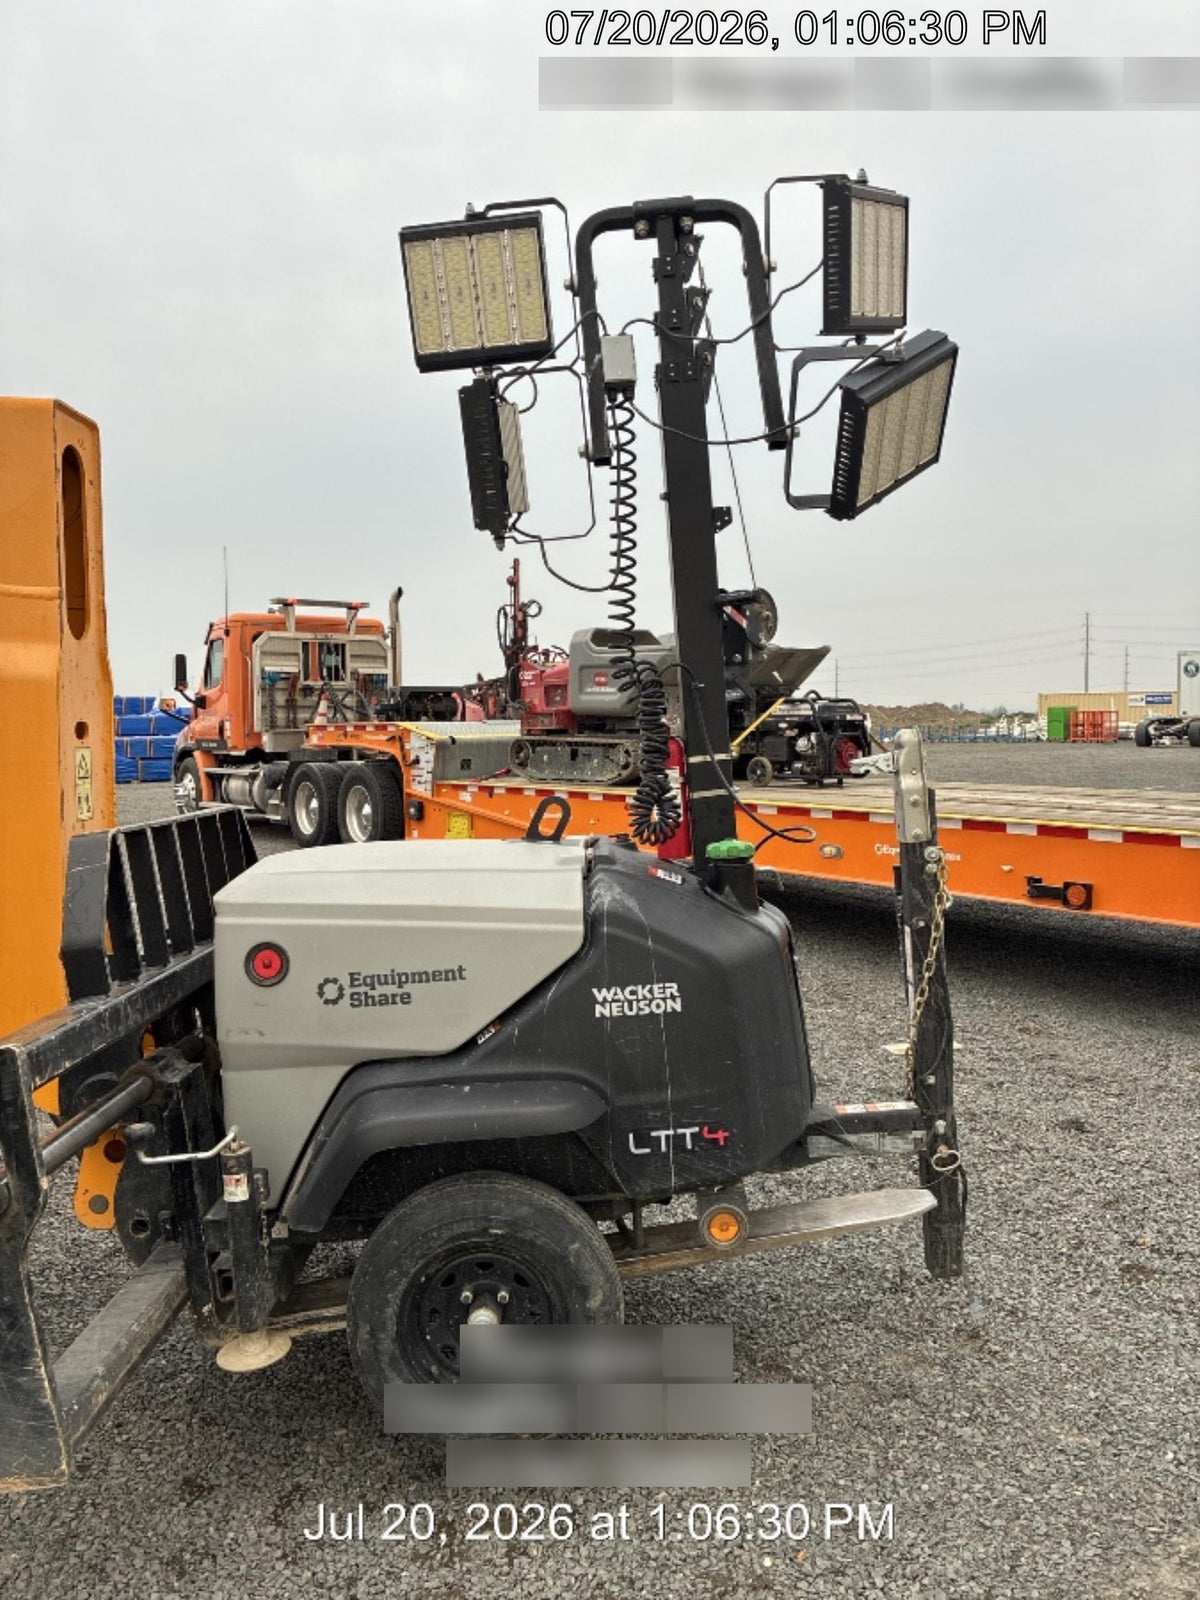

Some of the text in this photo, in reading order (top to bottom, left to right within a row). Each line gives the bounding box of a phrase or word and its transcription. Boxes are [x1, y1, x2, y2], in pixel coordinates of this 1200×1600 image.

[348, 965, 467, 990] Equipment
[350, 991, 412, 1008] Share
[592, 982, 681, 1002] WACKER
[595, 997, 683, 1018] NEUSON
[628, 1126, 730, 1155] LTT4
